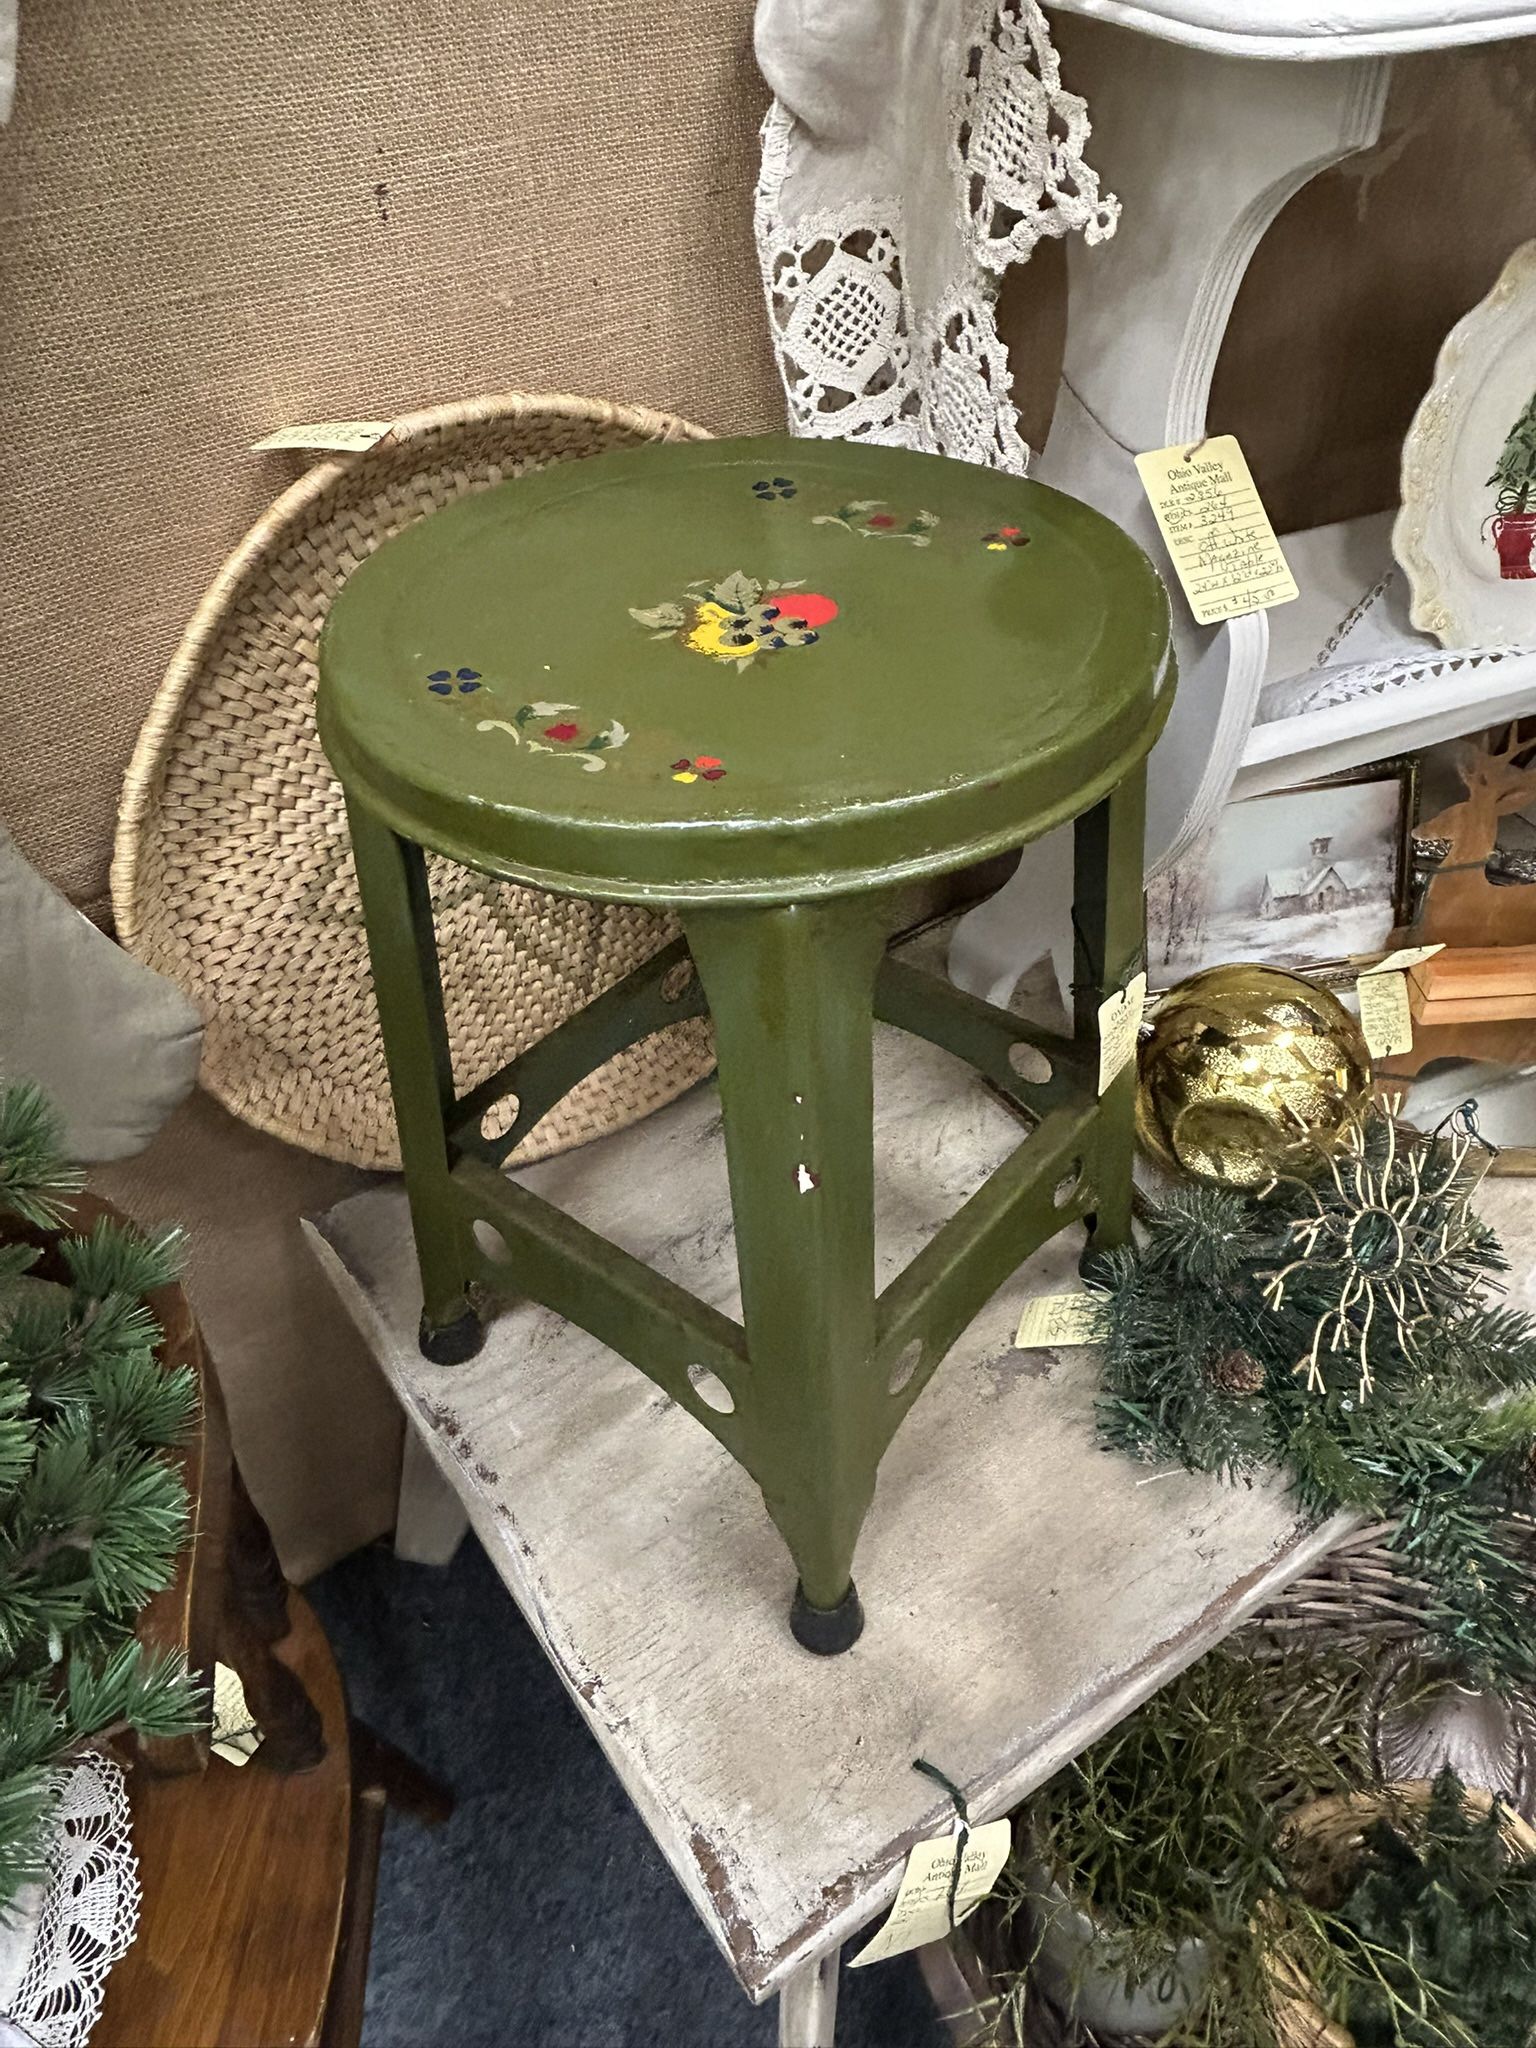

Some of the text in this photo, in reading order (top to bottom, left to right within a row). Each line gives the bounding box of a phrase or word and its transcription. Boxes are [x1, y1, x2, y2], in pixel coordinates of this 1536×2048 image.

[1168, 461, 1224, 481] Ohio Valley
[1170, 472, 1233, 495] Antique Mall
